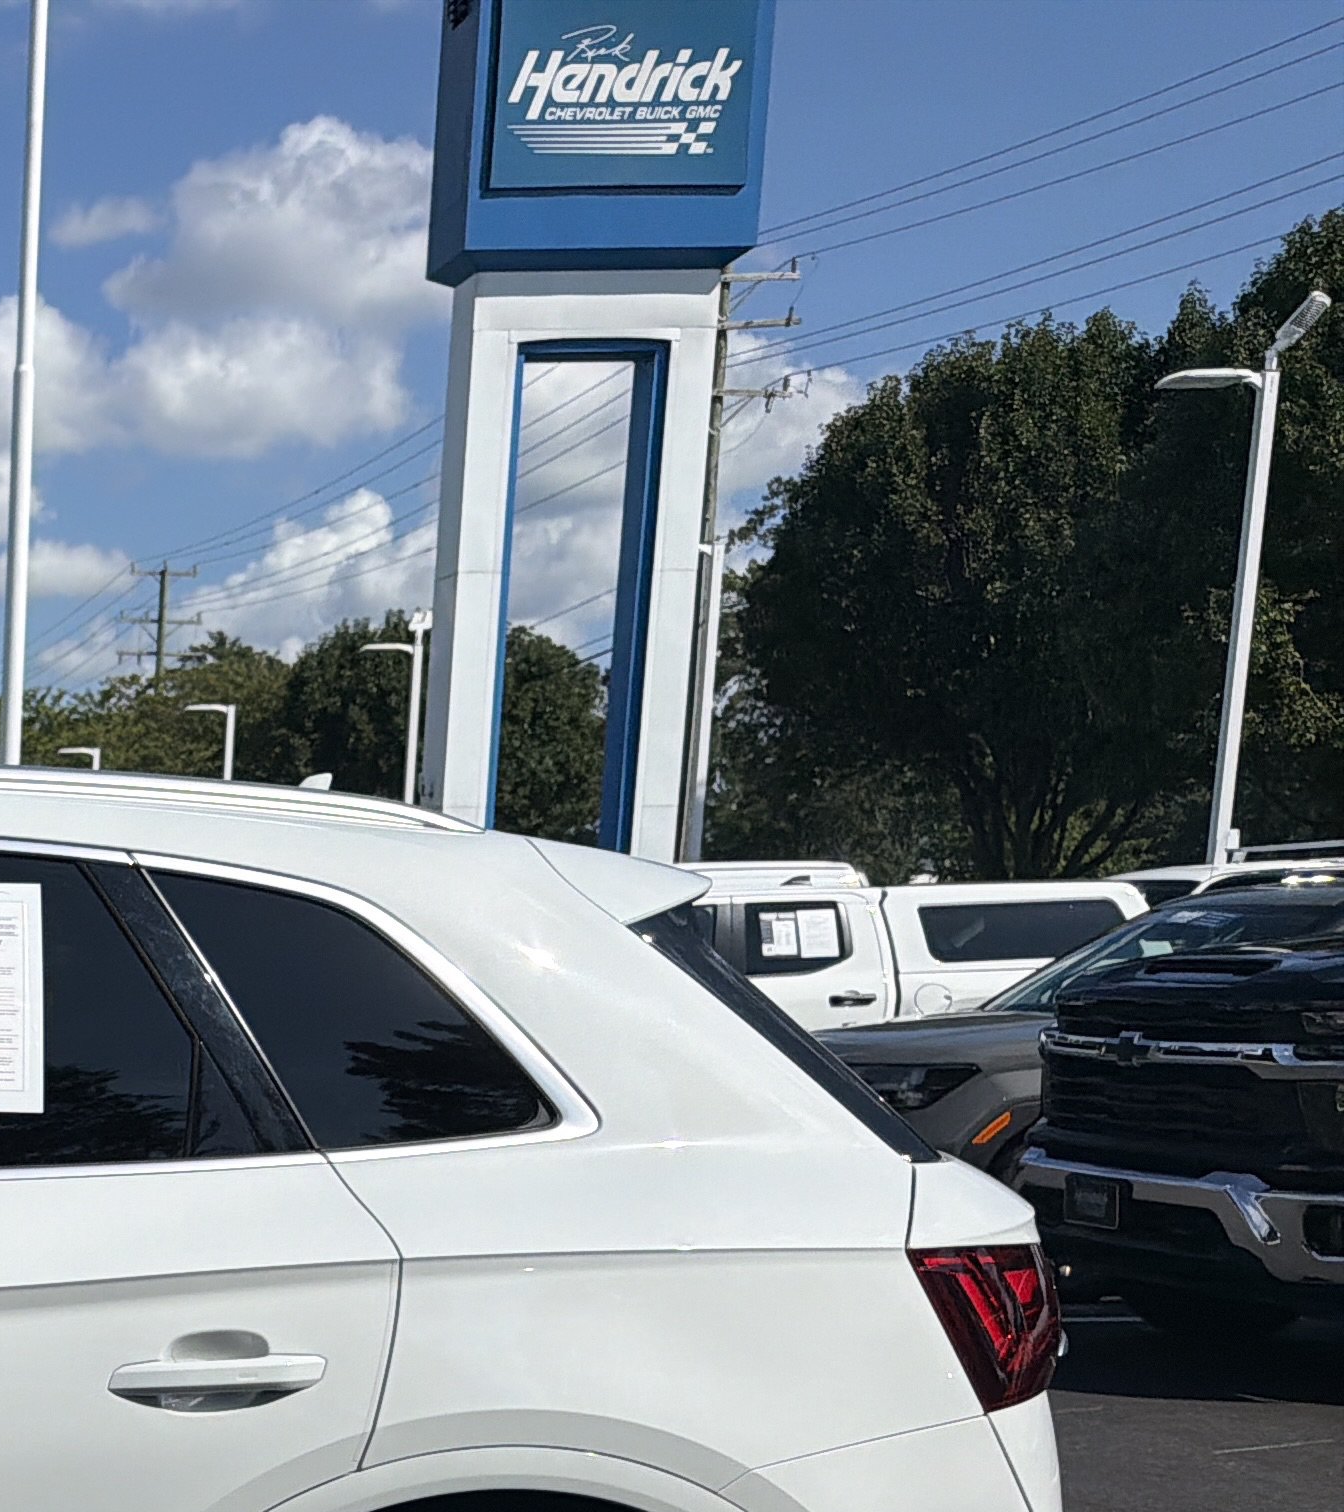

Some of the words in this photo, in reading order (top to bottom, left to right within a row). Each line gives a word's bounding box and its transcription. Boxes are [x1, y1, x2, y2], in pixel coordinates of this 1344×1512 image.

[507, 47, 743, 120] Hendrick
[545, 106, 633, 120] CHEVROLET
[634, 105, 681, 120] BUICK
[685, 104, 722, 119] GMC
